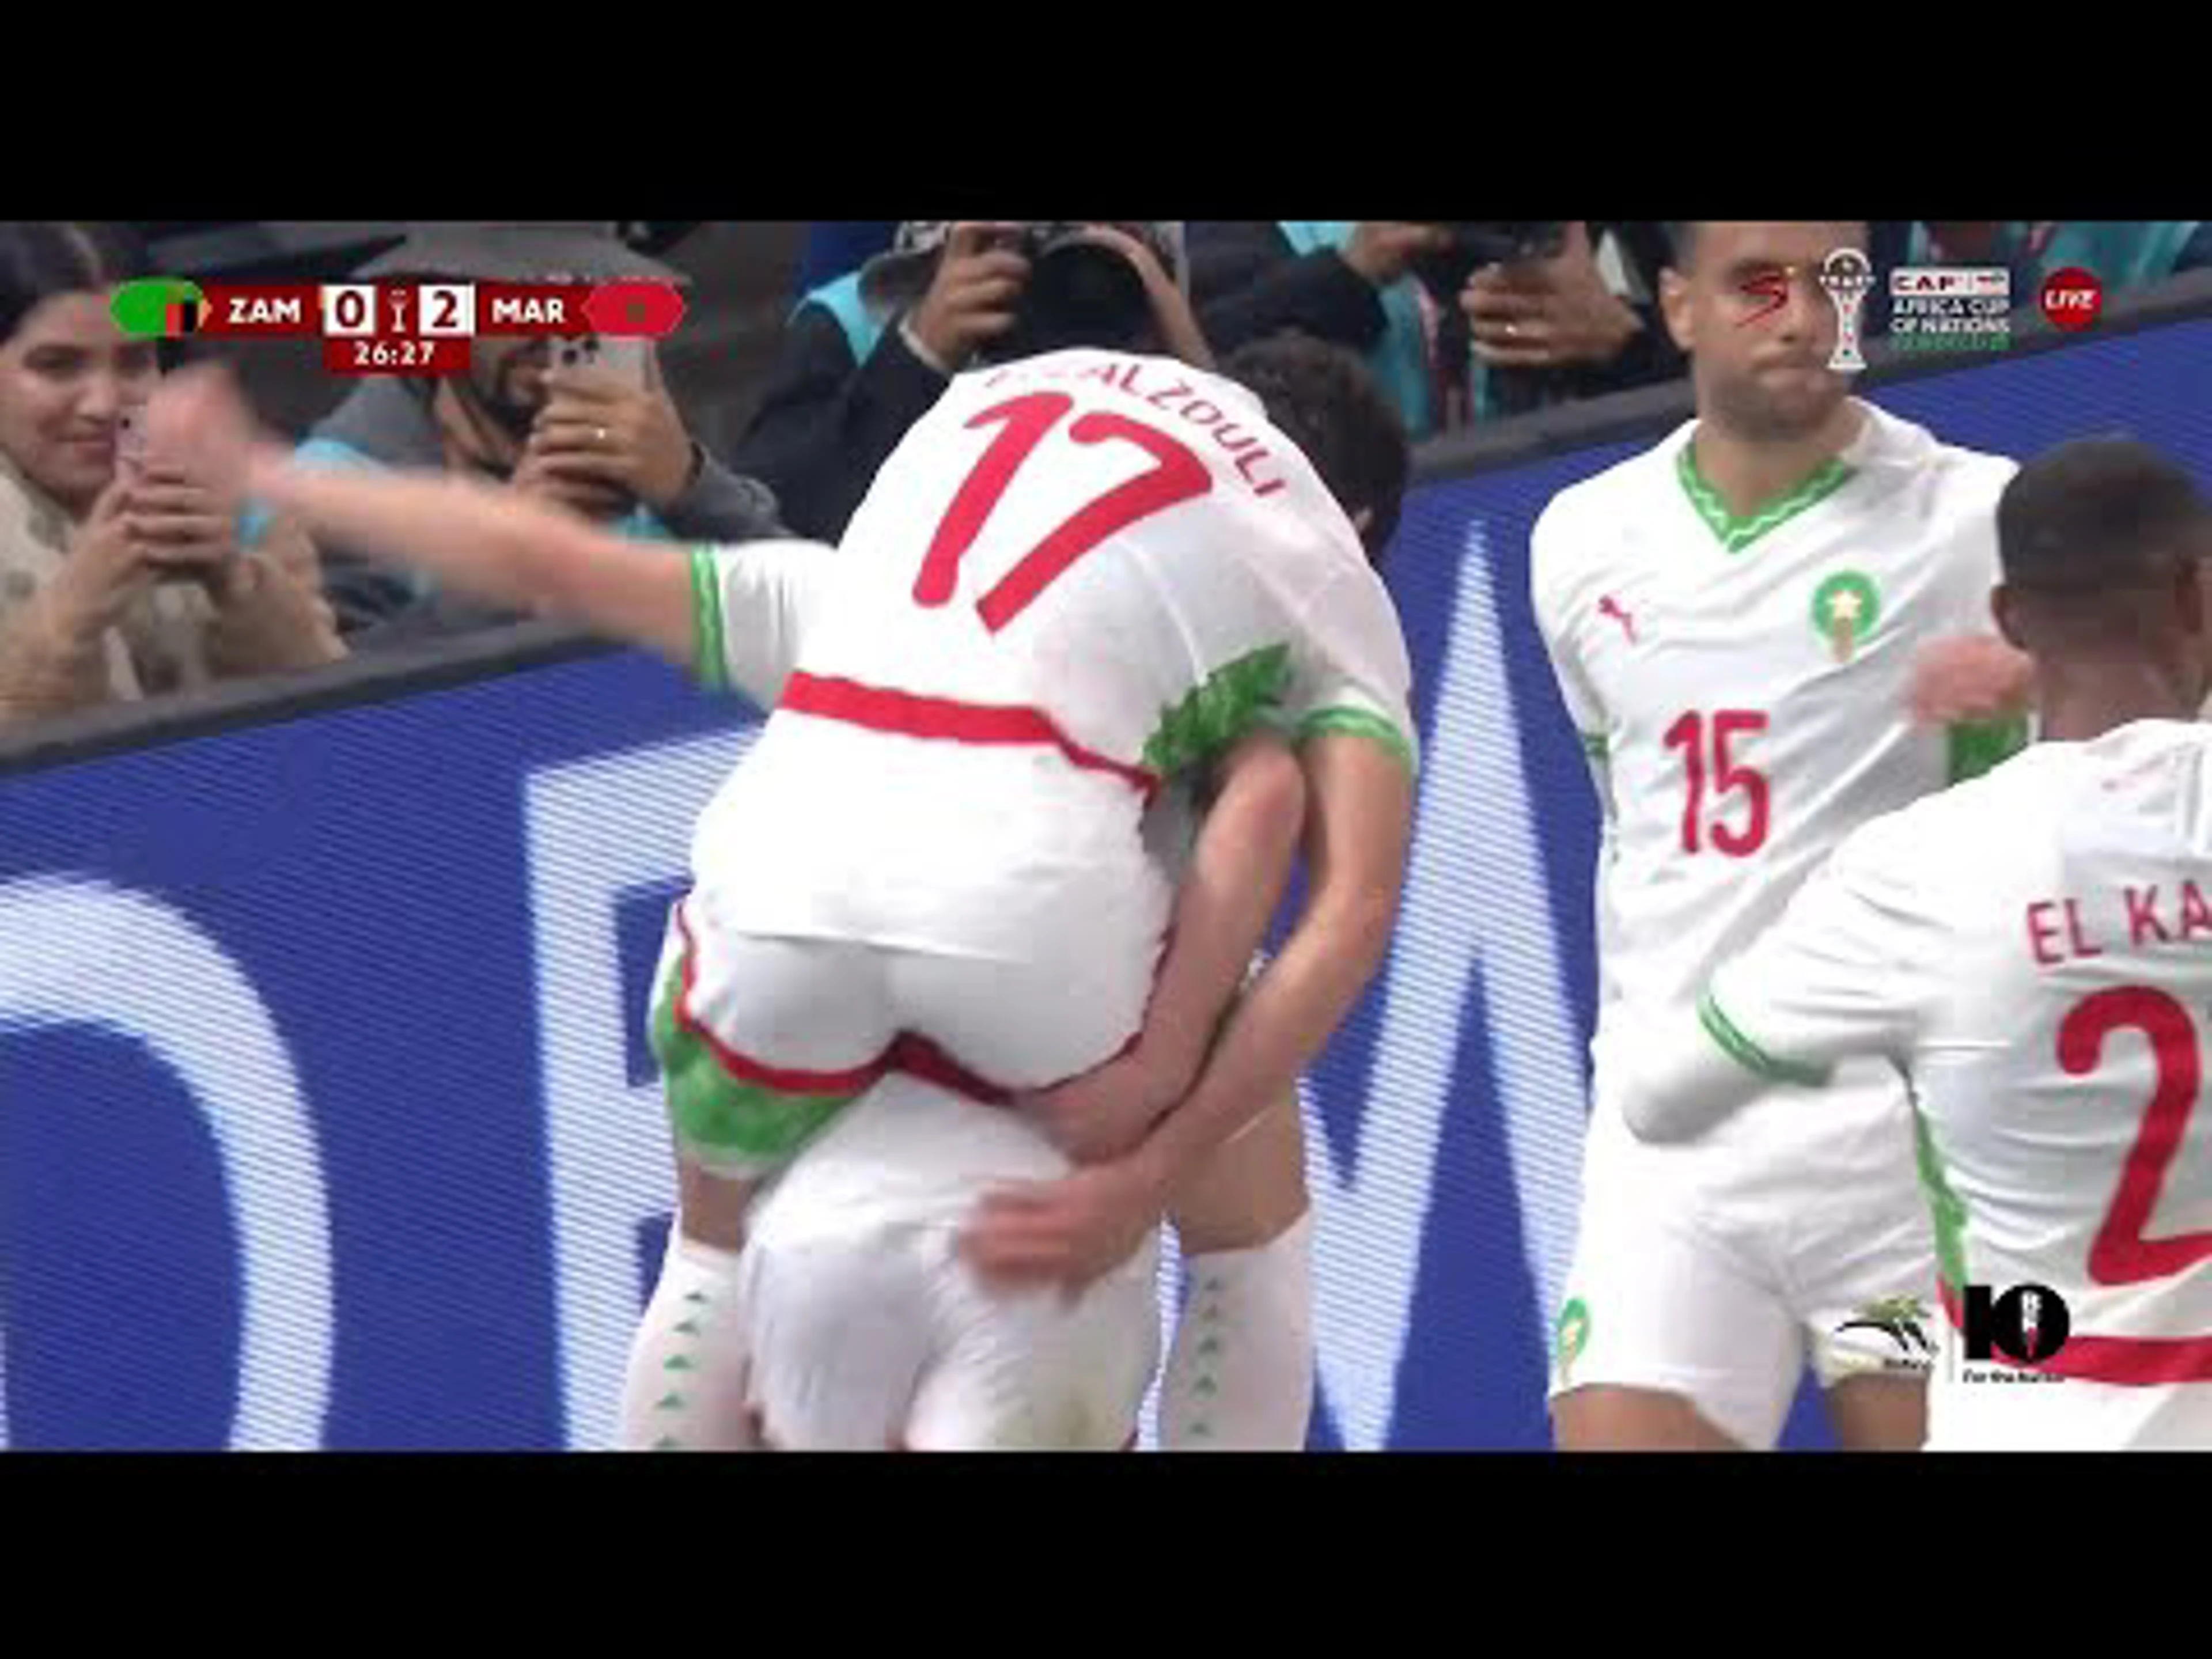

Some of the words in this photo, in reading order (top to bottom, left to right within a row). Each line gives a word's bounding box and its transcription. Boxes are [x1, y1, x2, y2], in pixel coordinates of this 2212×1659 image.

[911, 391, 1213, 632] 17
[1665, 710, 1767, 857] 15
[2027, 897, 2103, 965] EL
